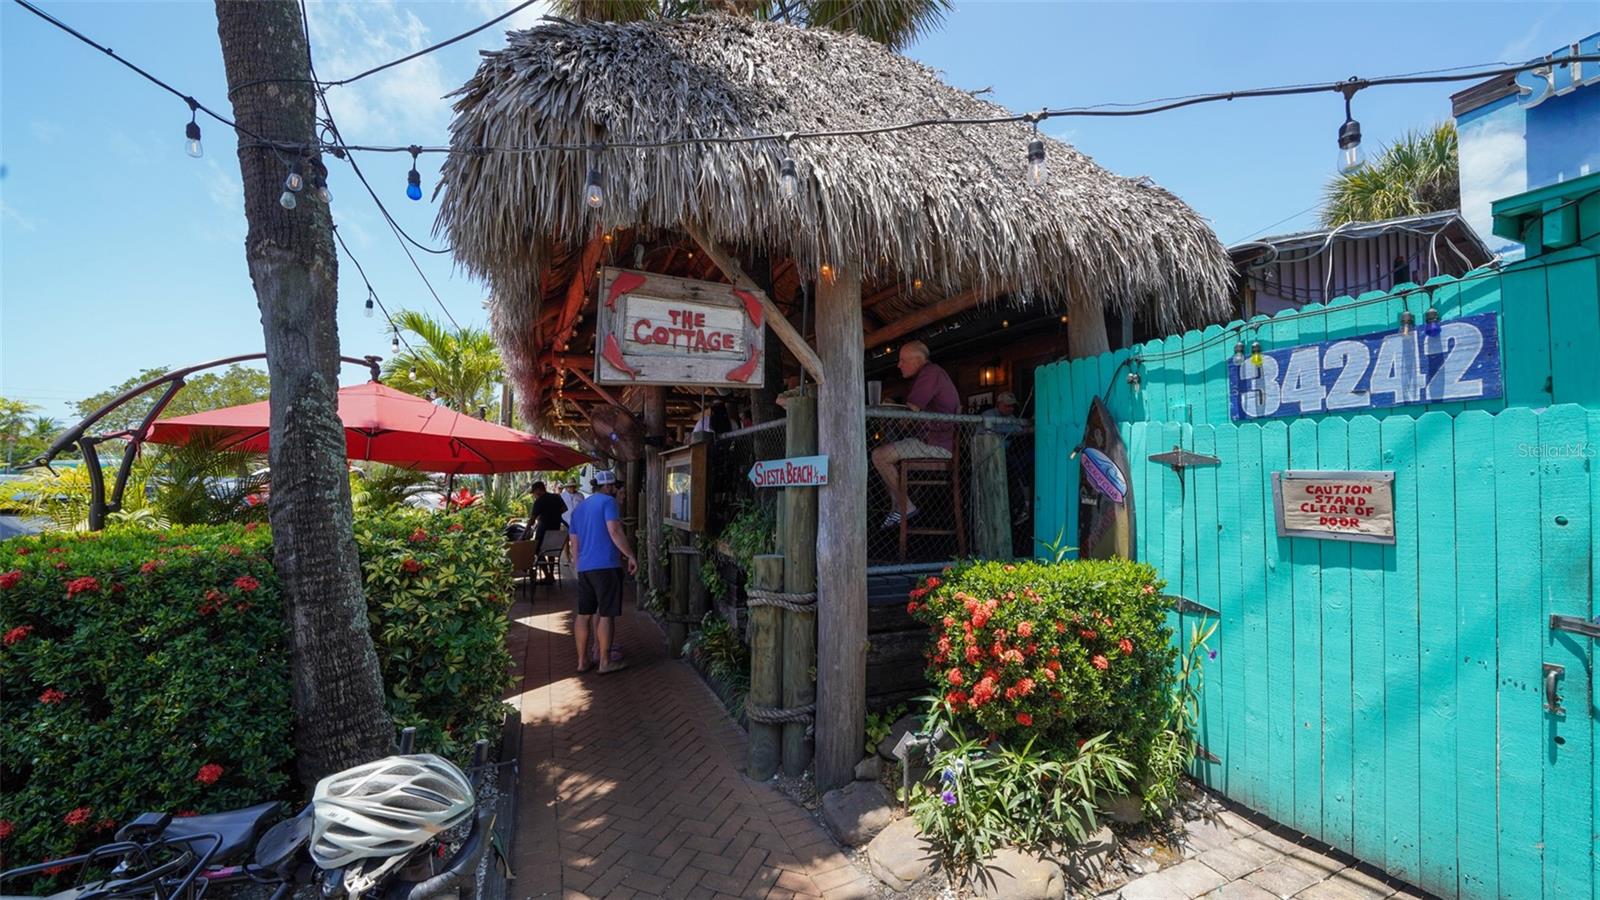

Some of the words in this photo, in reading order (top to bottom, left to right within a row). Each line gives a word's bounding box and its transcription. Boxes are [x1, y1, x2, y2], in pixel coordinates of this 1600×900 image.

[668, 309, 706, 330] THE
[633, 319, 735, 352] COTTAGE
[1239, 322, 1483, 417] 34242
[755, 463, 785, 485] SIESTA
[786, 462, 813, 484] BEACH
[1305, 485, 1373, 495] CAUTION
[1315, 495, 1366, 506] STAND
[1300, 503, 1348, 514] CLEAR
[1355, 507, 1375, 516] OF
[1319, 516, 1360, 527] DOOR
